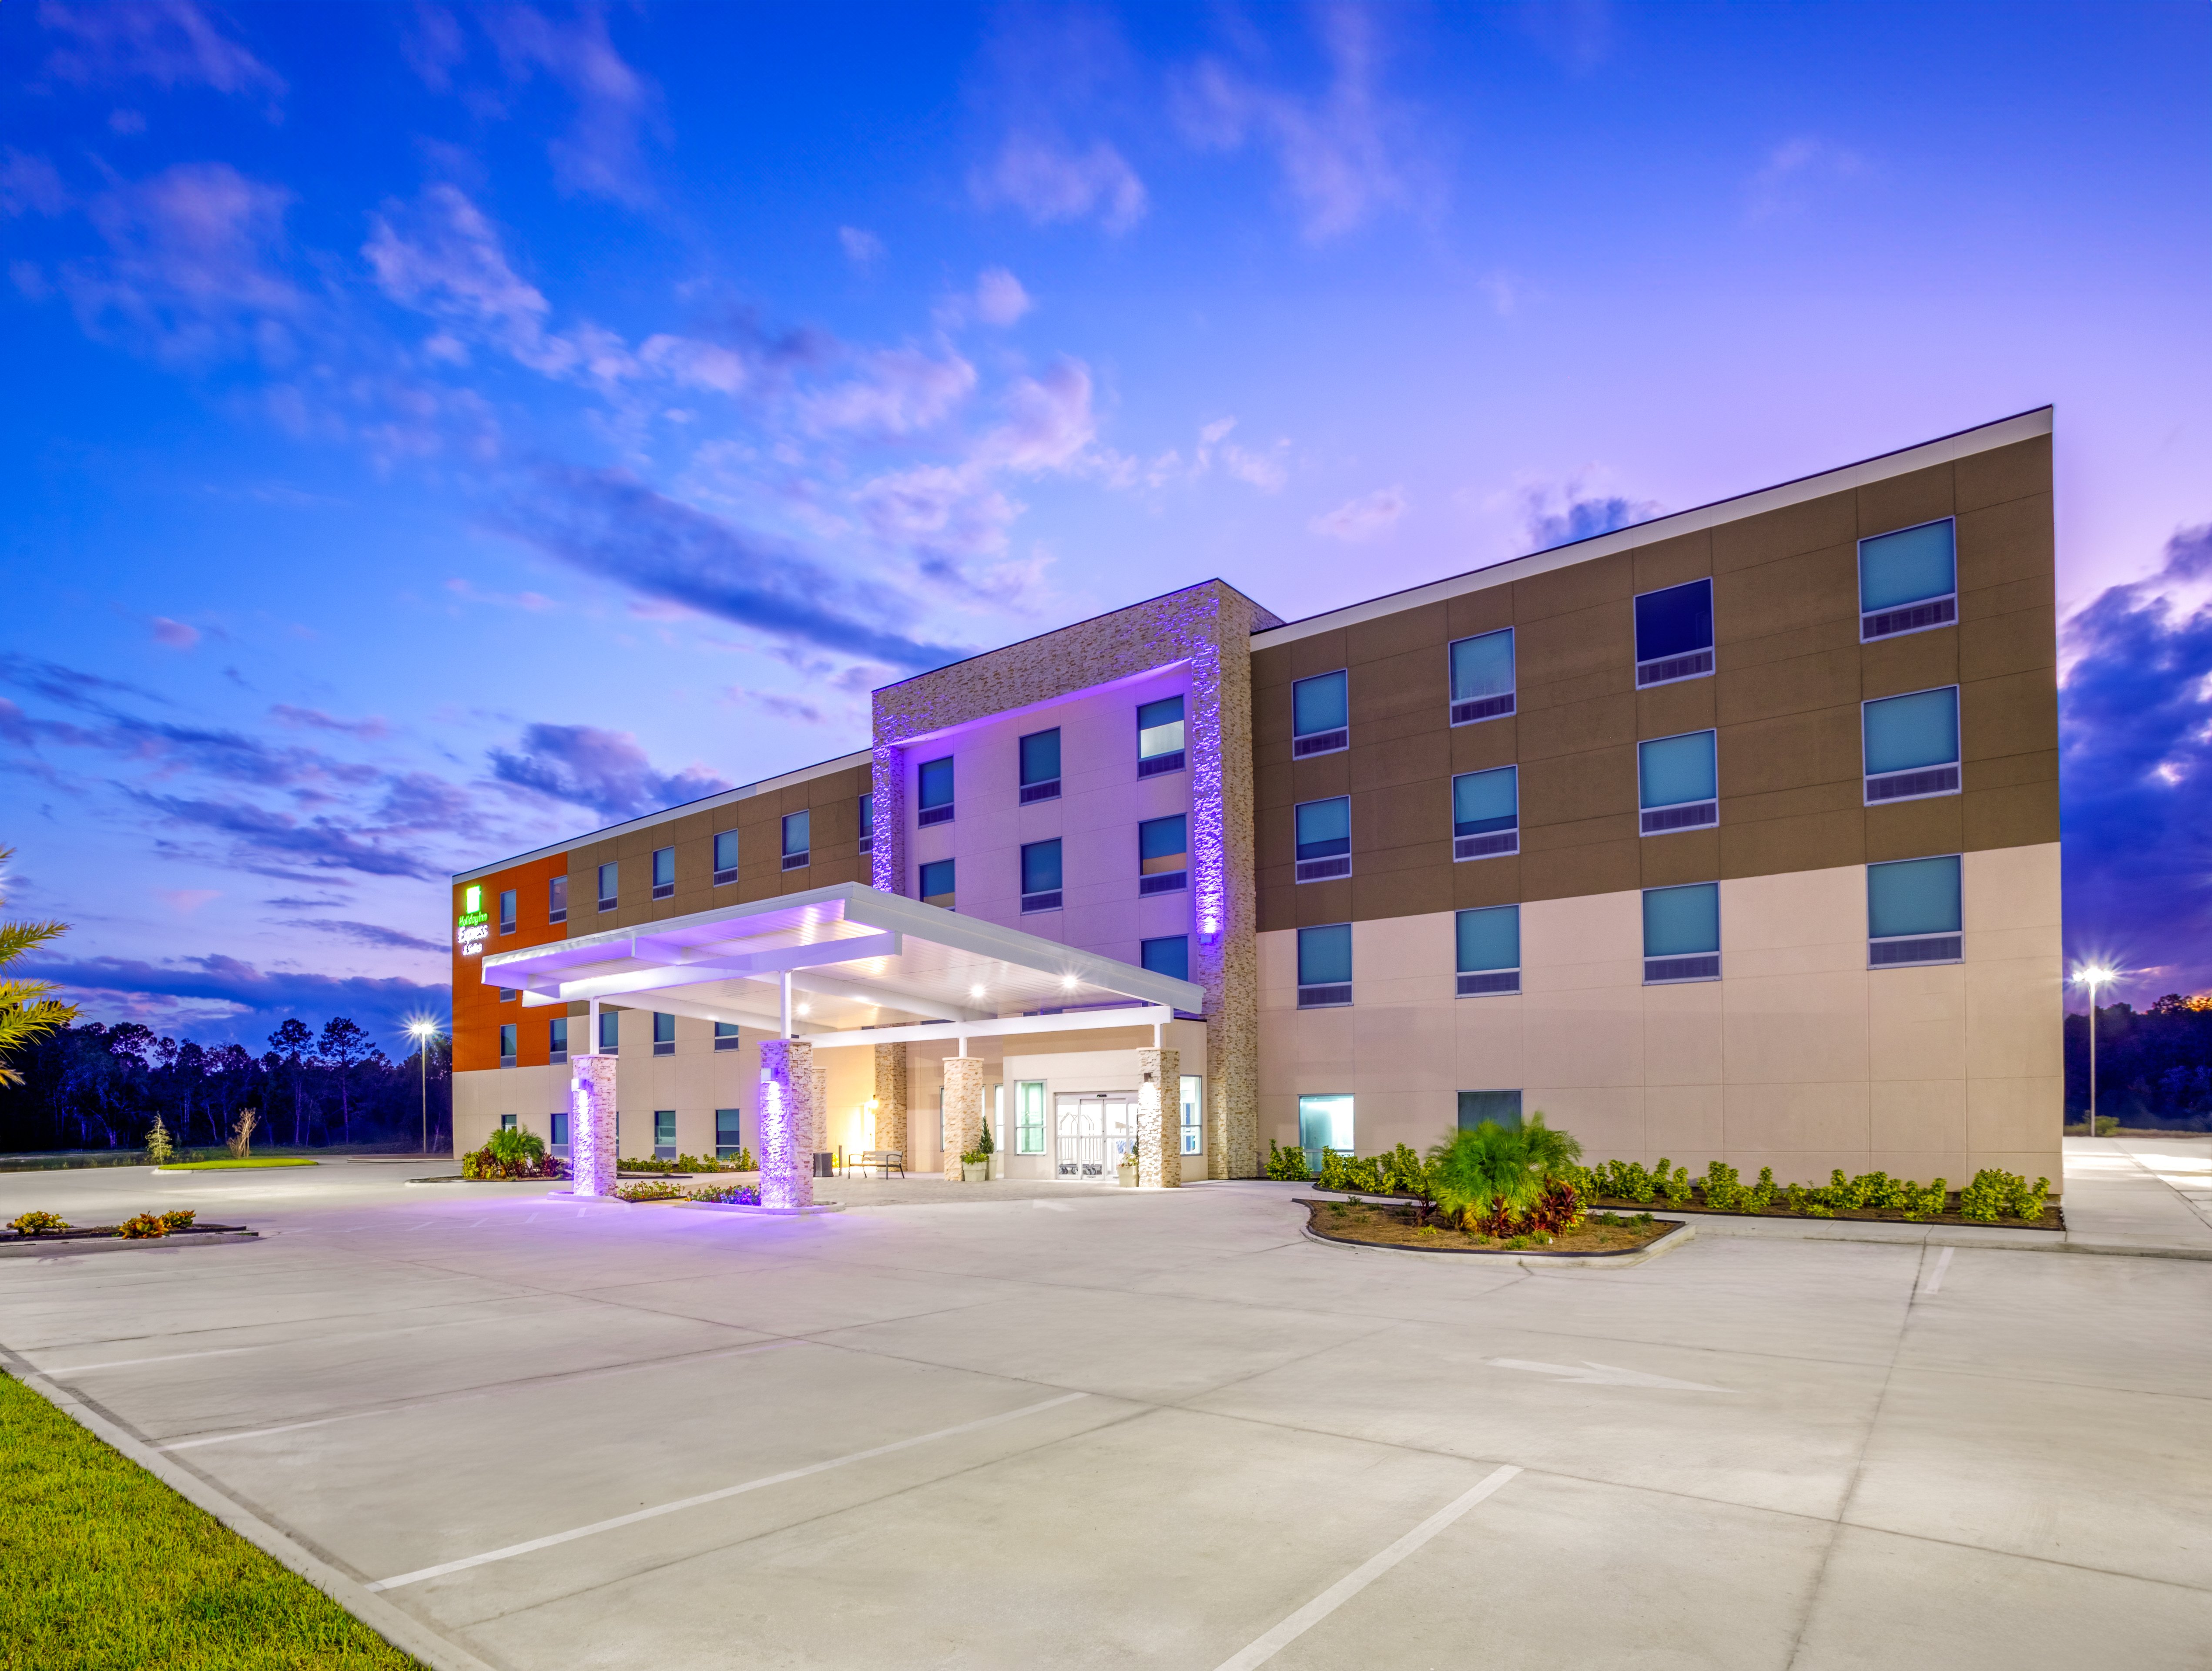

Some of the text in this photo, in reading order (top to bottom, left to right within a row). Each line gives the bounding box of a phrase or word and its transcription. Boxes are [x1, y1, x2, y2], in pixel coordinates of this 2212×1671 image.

[459, 912, 487, 927] Holiday Inn
[458, 925, 488, 944] Express
